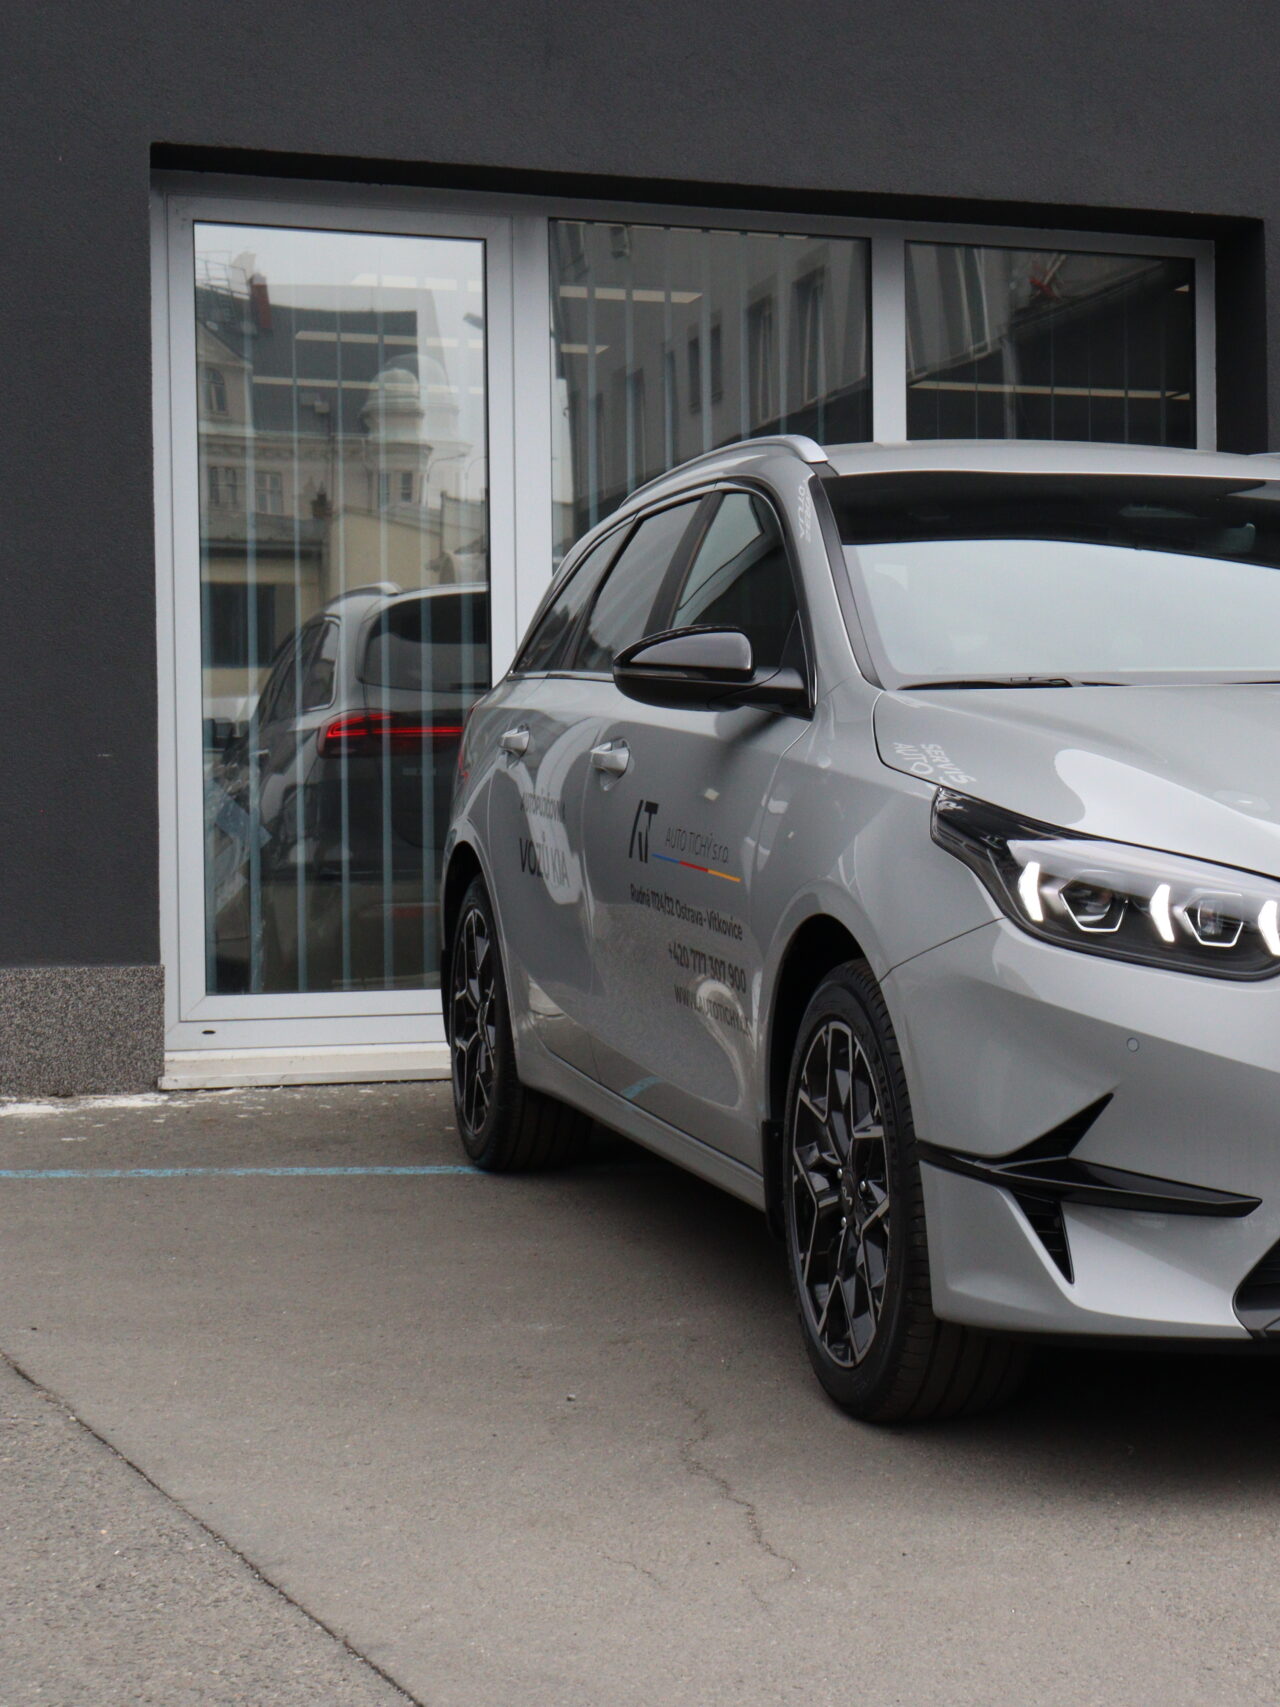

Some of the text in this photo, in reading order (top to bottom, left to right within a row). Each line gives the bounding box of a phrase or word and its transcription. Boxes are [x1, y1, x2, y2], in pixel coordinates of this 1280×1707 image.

[664, 826, 688, 852] AUTO
[689, 947, 707, 977] 777
[728, 962, 747, 994] 900
